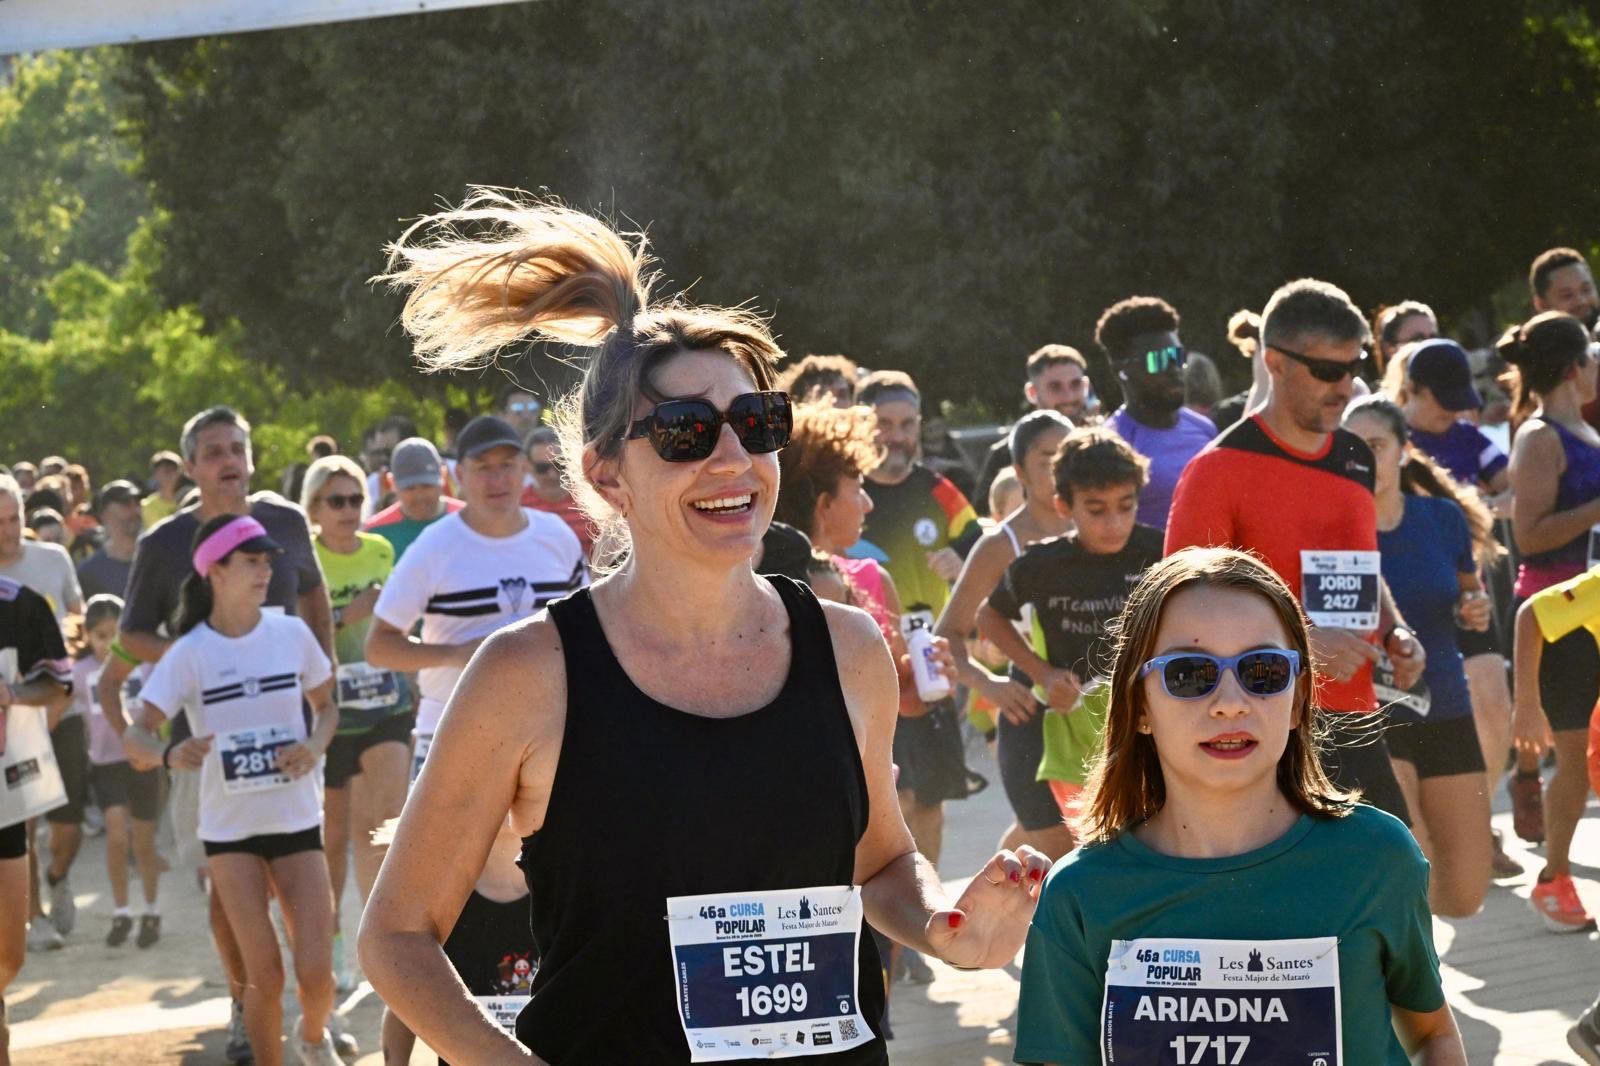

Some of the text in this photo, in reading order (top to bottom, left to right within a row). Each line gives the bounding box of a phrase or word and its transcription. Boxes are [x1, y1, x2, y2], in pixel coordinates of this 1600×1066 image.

[1318, 575, 1362, 591] JORDI
[1323, 593, 1359, 610] 2427
[233, 750, 278, 775] 281
[699, 903, 765, 919] 46a CURSA
[778, 903, 842, 919] Les Santes
[715, 919, 766, 934] POPULAR
[722, 942, 816, 977] ESTEL
[1136, 949, 1201, 963] 46a CURSA
[1219, 956, 1314, 970] Les Santes
[1146, 964, 1202, 982] POPULAR
[1223, 972, 1310, 983] Festa Major de Mataró
[735, 982, 808, 1017] 1699
[1133, 995, 1289, 1023] ARIADNA
[1169, 1035, 1251, 1065] 1717
